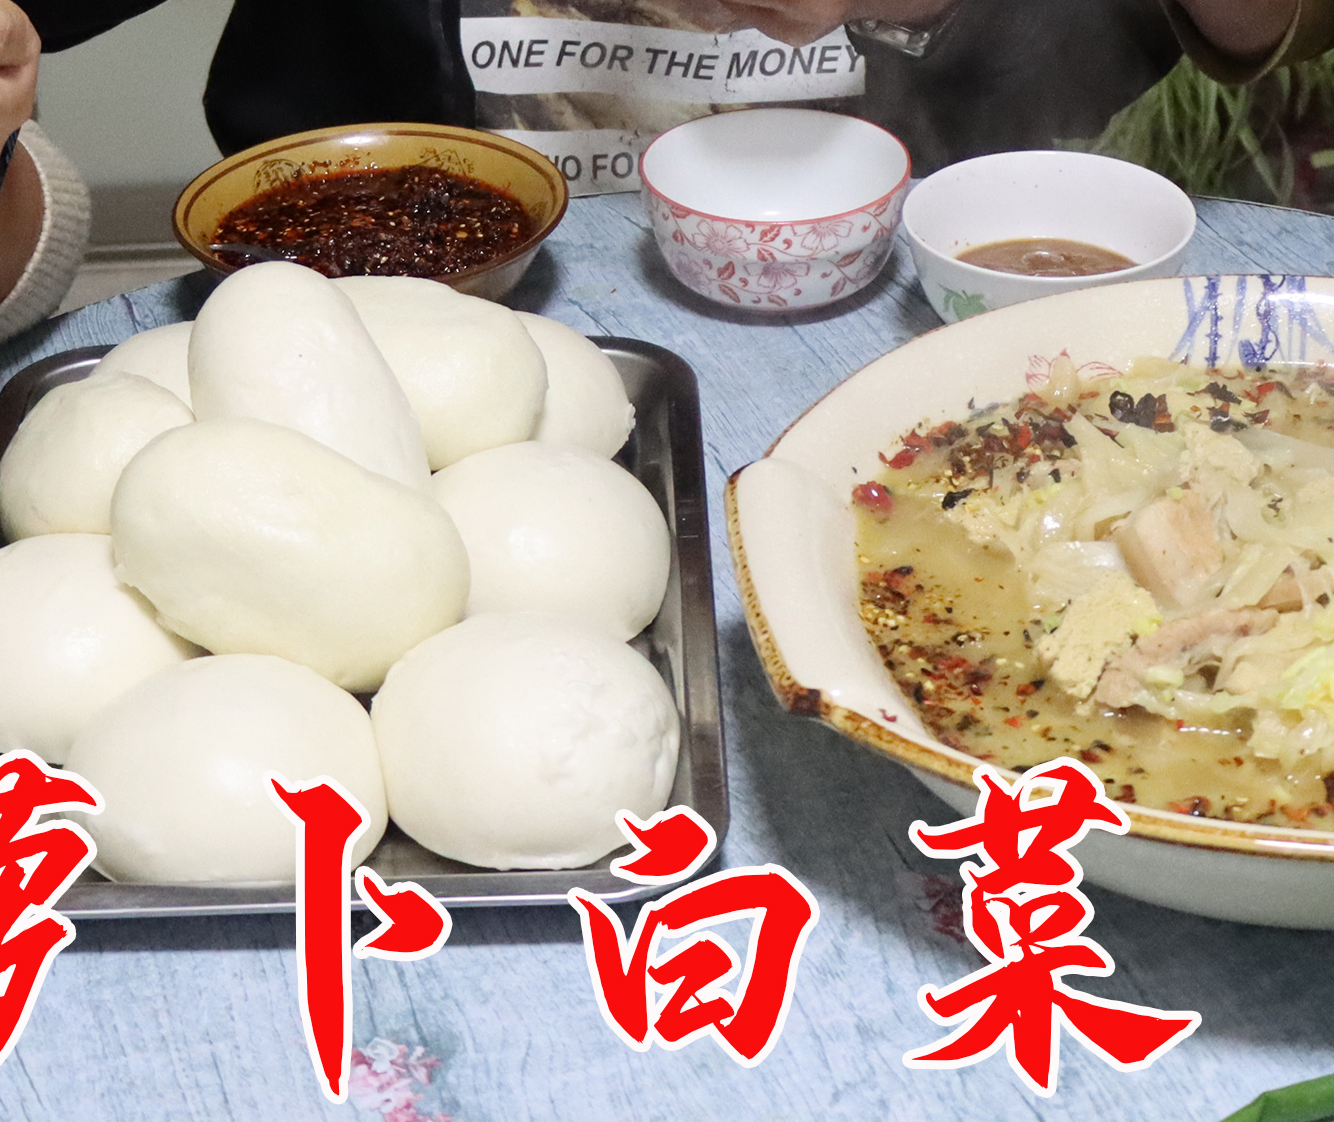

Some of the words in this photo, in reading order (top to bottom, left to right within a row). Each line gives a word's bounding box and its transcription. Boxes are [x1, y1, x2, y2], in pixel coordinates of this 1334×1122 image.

[471, 39, 549, 69] ONE
[555, 40, 634, 72] FOR
[645, 47, 720, 81] THE
[726, 44, 865, 79] MONEY
[591, 151, 643, 181] FO
